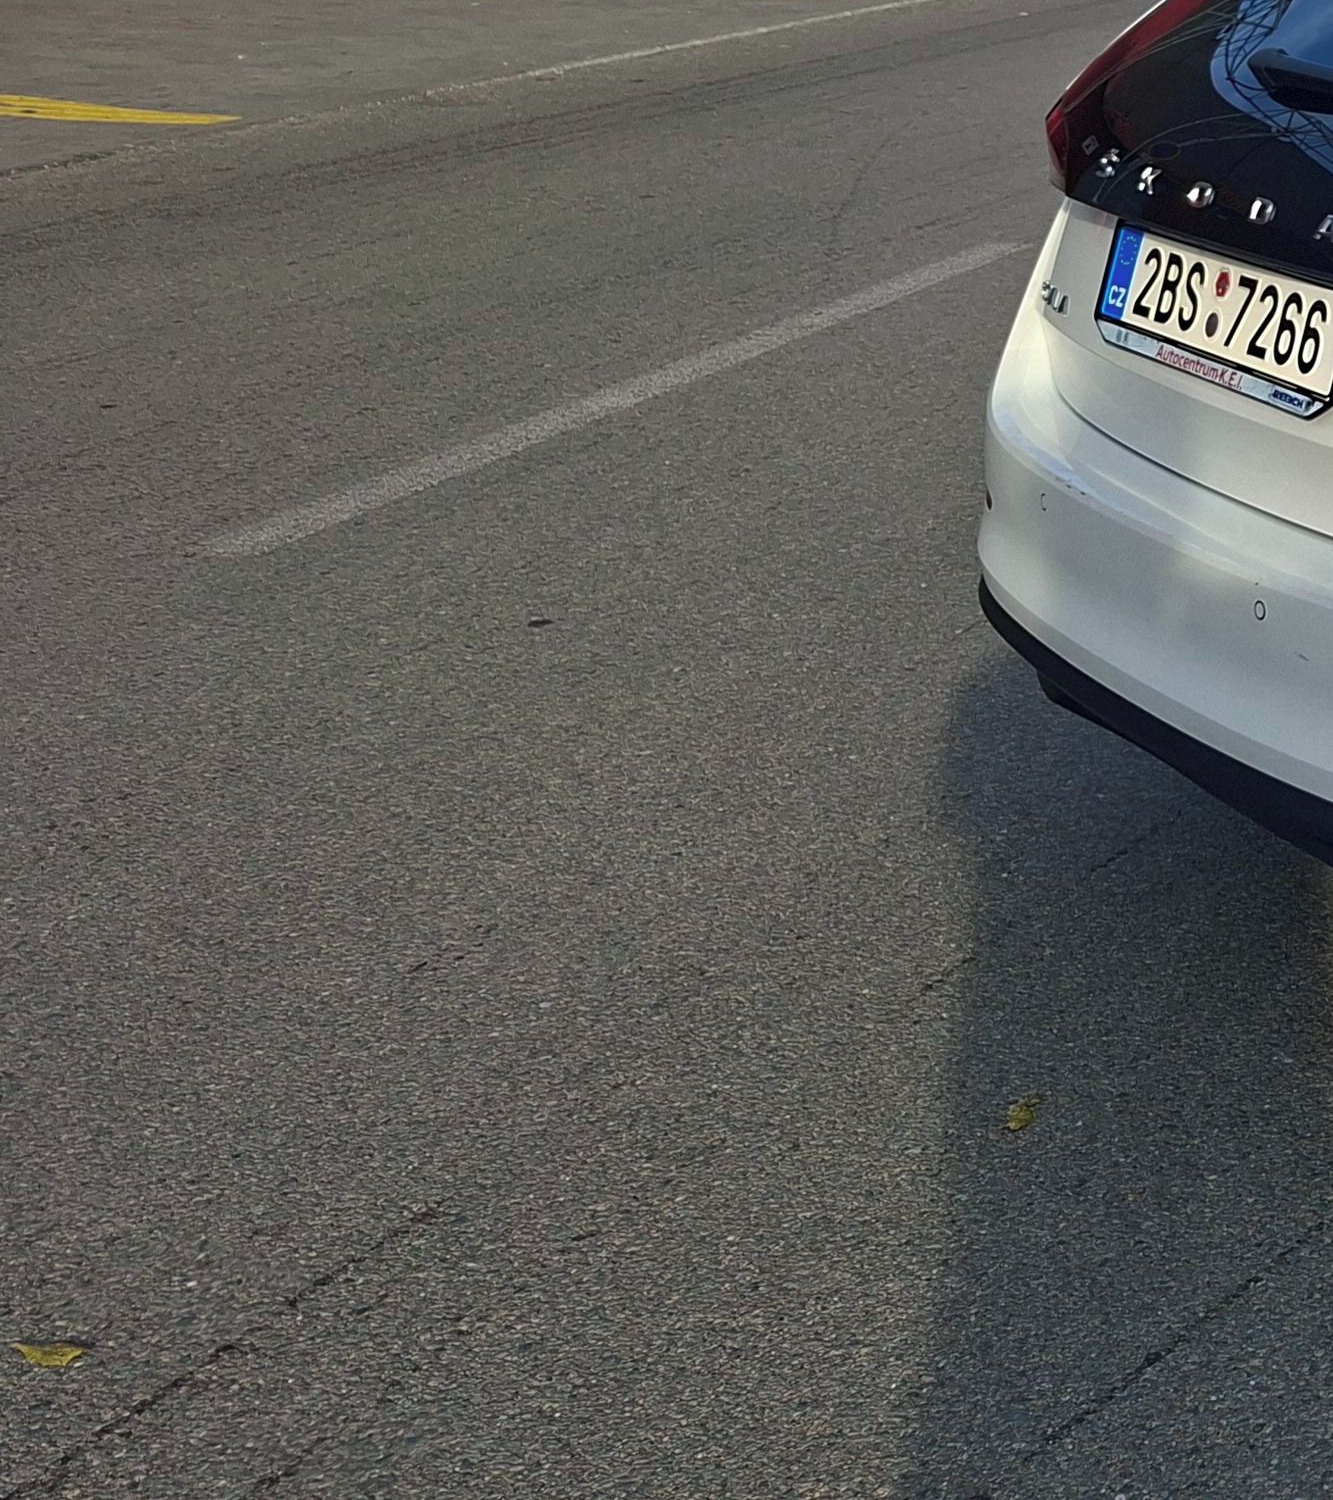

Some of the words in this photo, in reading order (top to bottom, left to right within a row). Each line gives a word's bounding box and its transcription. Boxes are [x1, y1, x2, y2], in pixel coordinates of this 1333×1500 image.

[1108, 285, 1127, 308] CZ
[1133, 248, 1205, 331] 2BS
[1224, 275, 1328, 374] 7266
